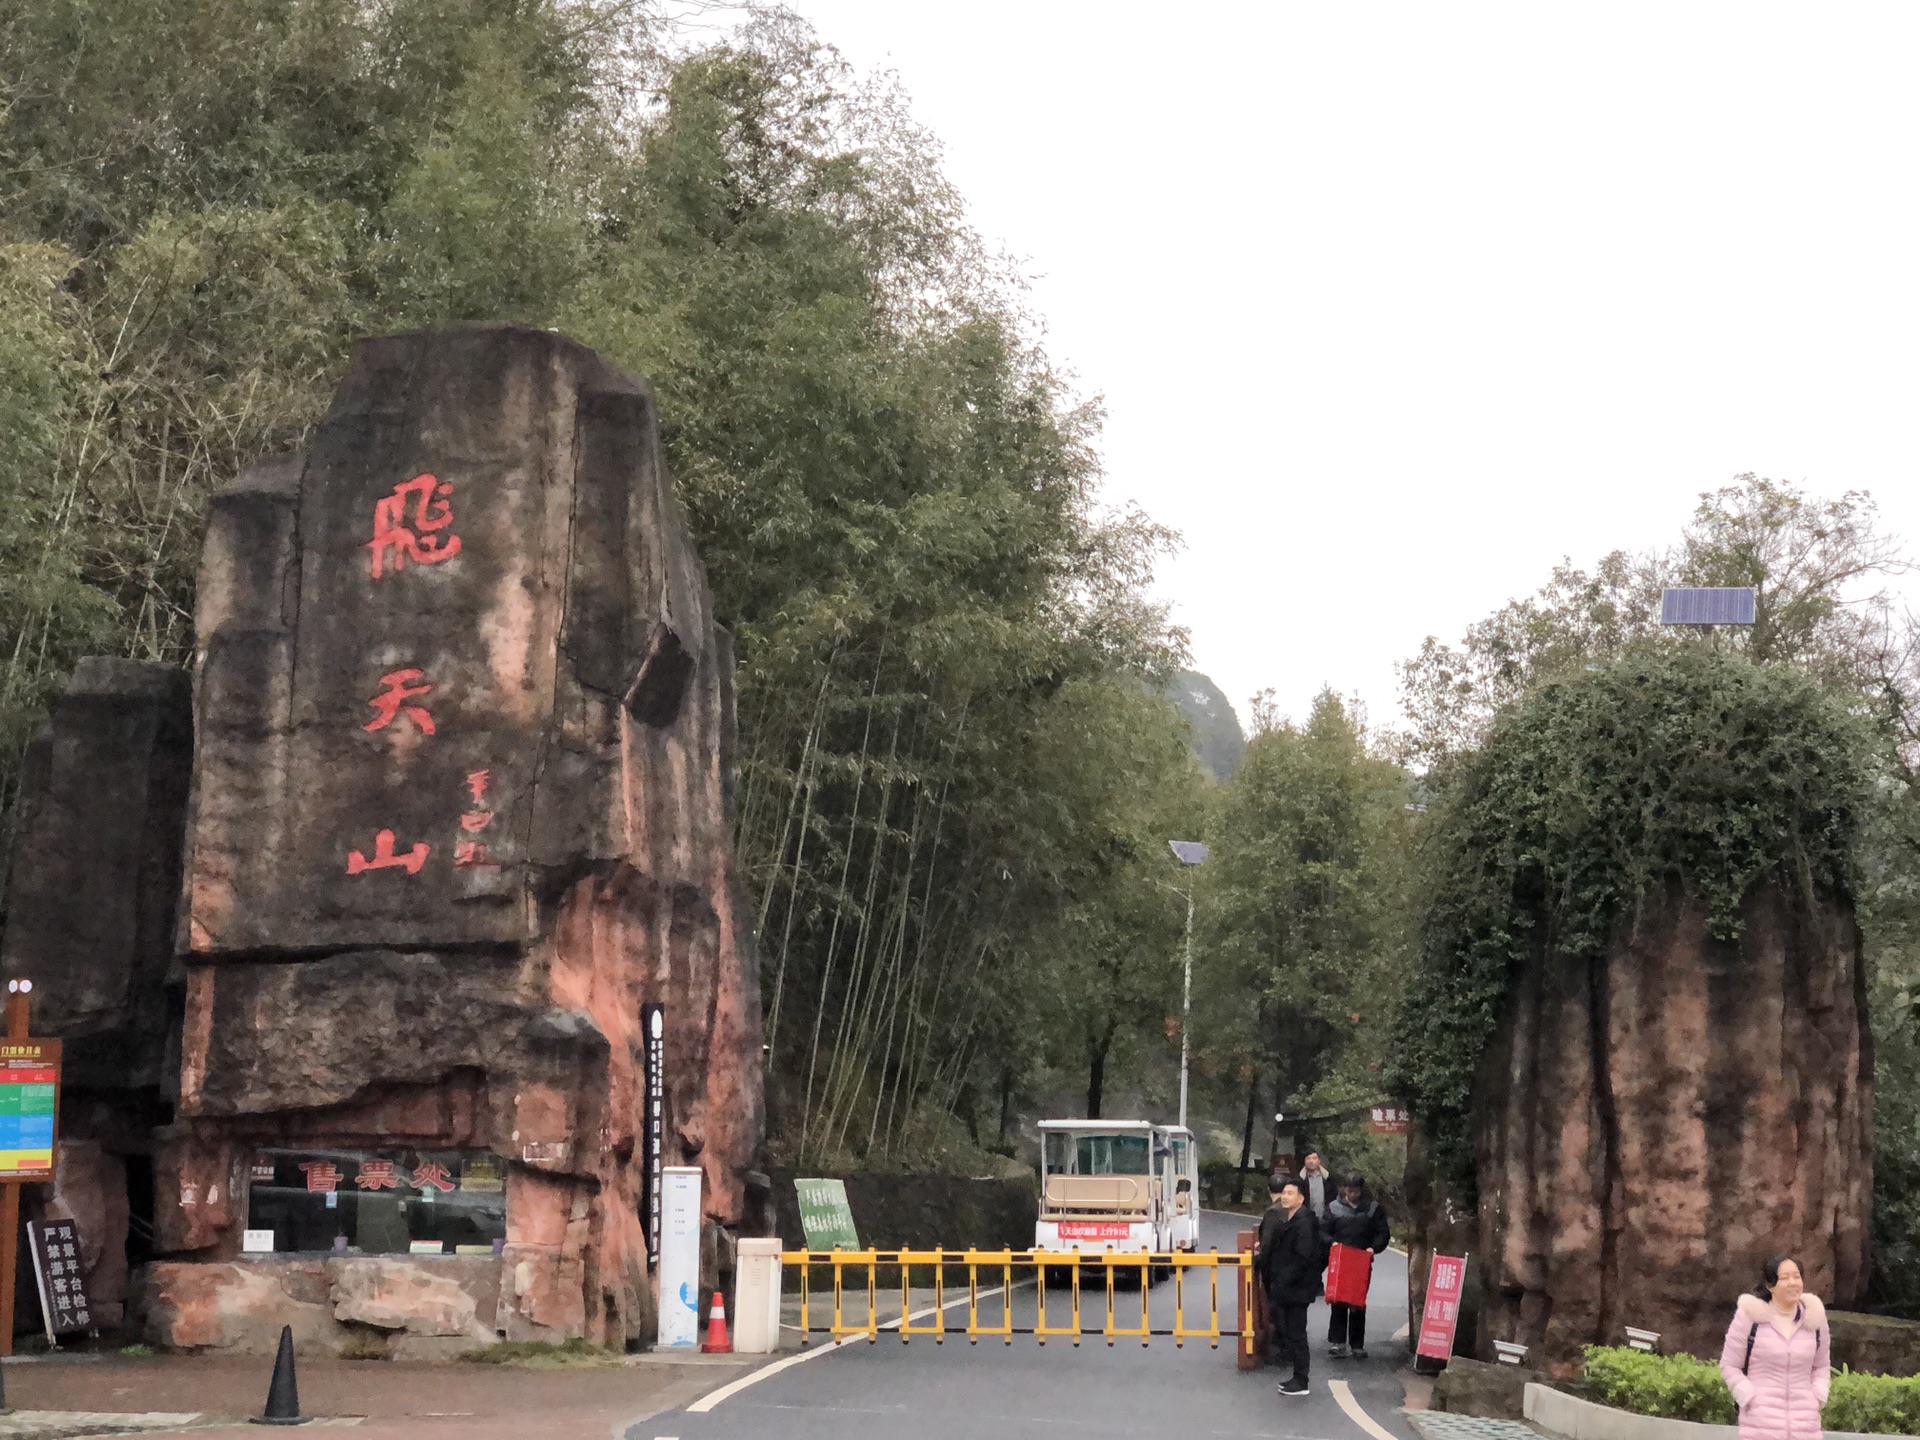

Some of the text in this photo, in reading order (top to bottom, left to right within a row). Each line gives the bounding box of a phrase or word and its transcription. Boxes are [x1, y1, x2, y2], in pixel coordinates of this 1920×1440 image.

[1372, 1108, 1409, 1121] 验票处
[298, 1160, 456, 1193] 售票处
[43, 1227, 75, 1327] 严禁游客进入
[58, 1226, 90, 1325] 观景平台检修
